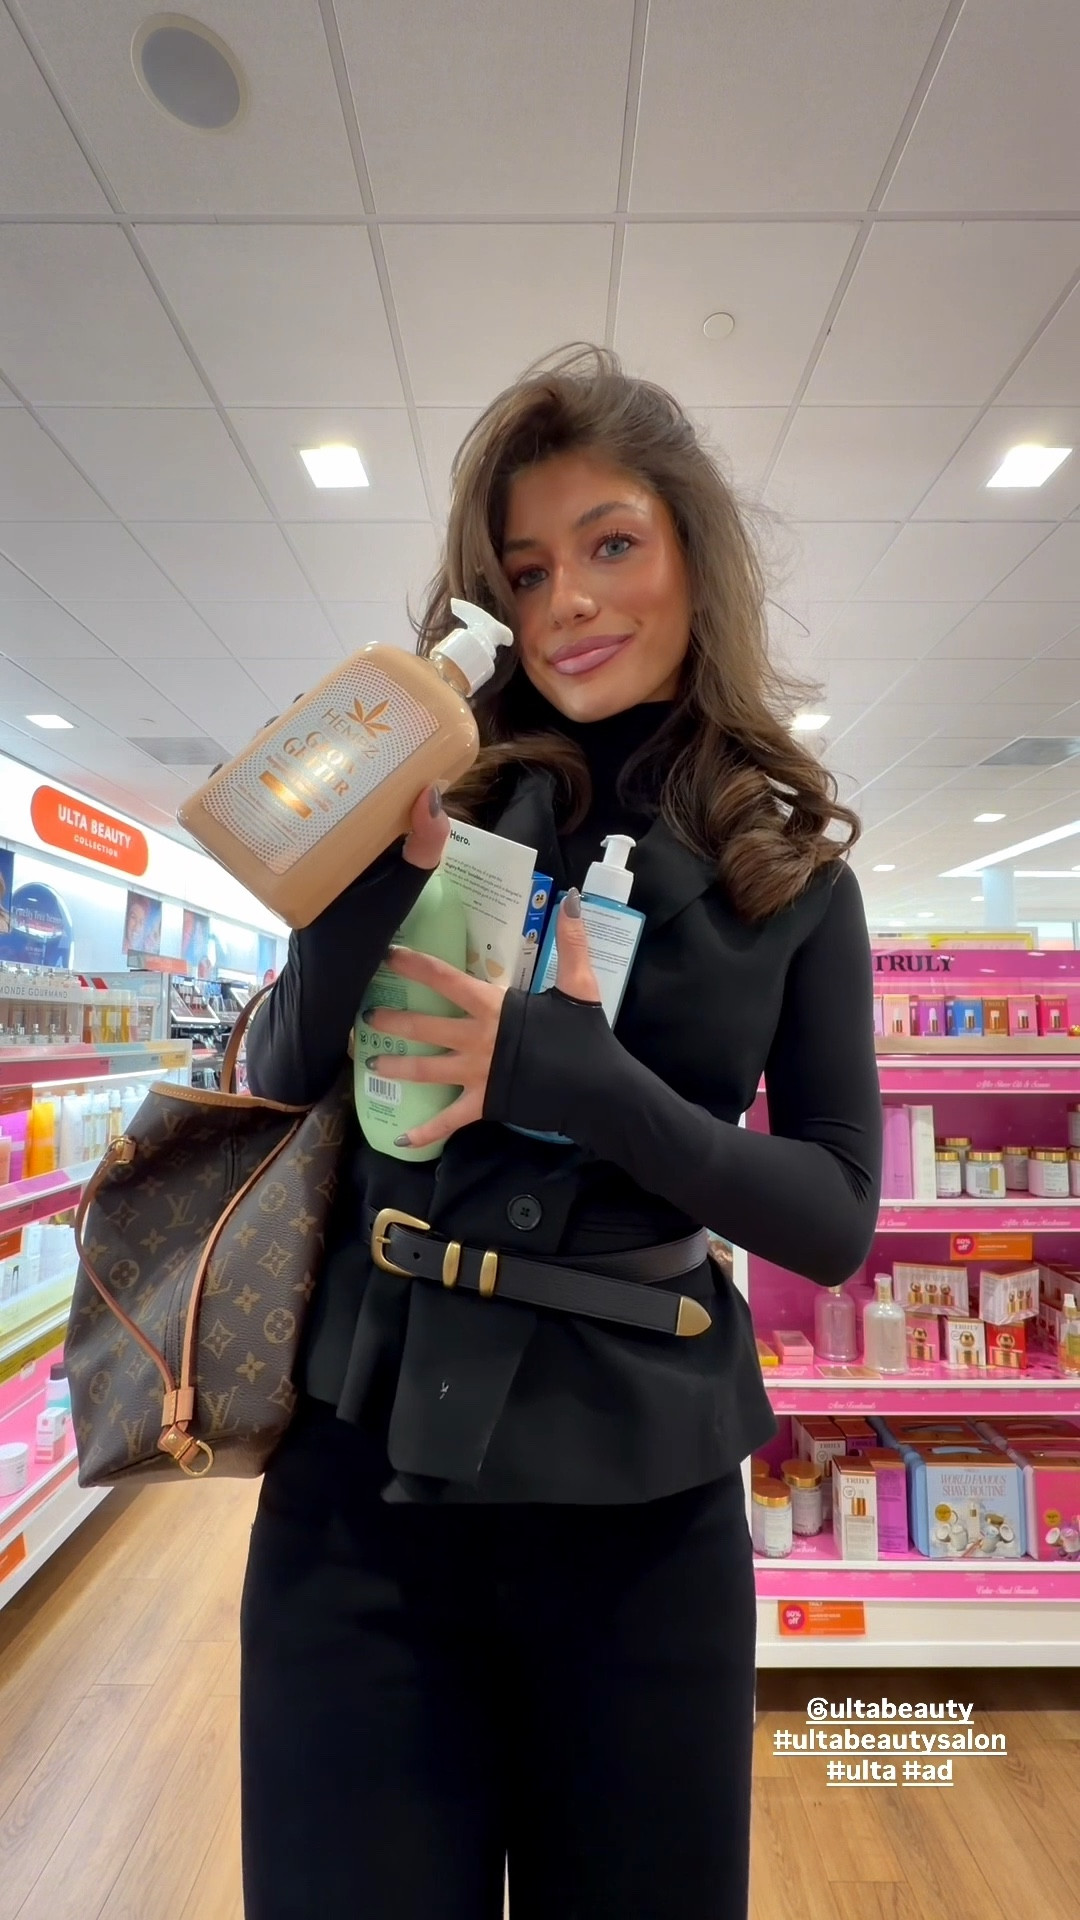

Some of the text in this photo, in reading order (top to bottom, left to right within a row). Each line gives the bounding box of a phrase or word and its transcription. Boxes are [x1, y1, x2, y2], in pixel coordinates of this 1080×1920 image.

[321, 707, 380, 759] HEMPZ
[57, 804, 132, 849] ULTA BEAUTY
[73, 834, 119, 858] COLLECTION
[449, 830, 471, 846] Hero.
[875, 954, 954, 972] TRULY
[28, 987, 68, 999] GOURMAND
